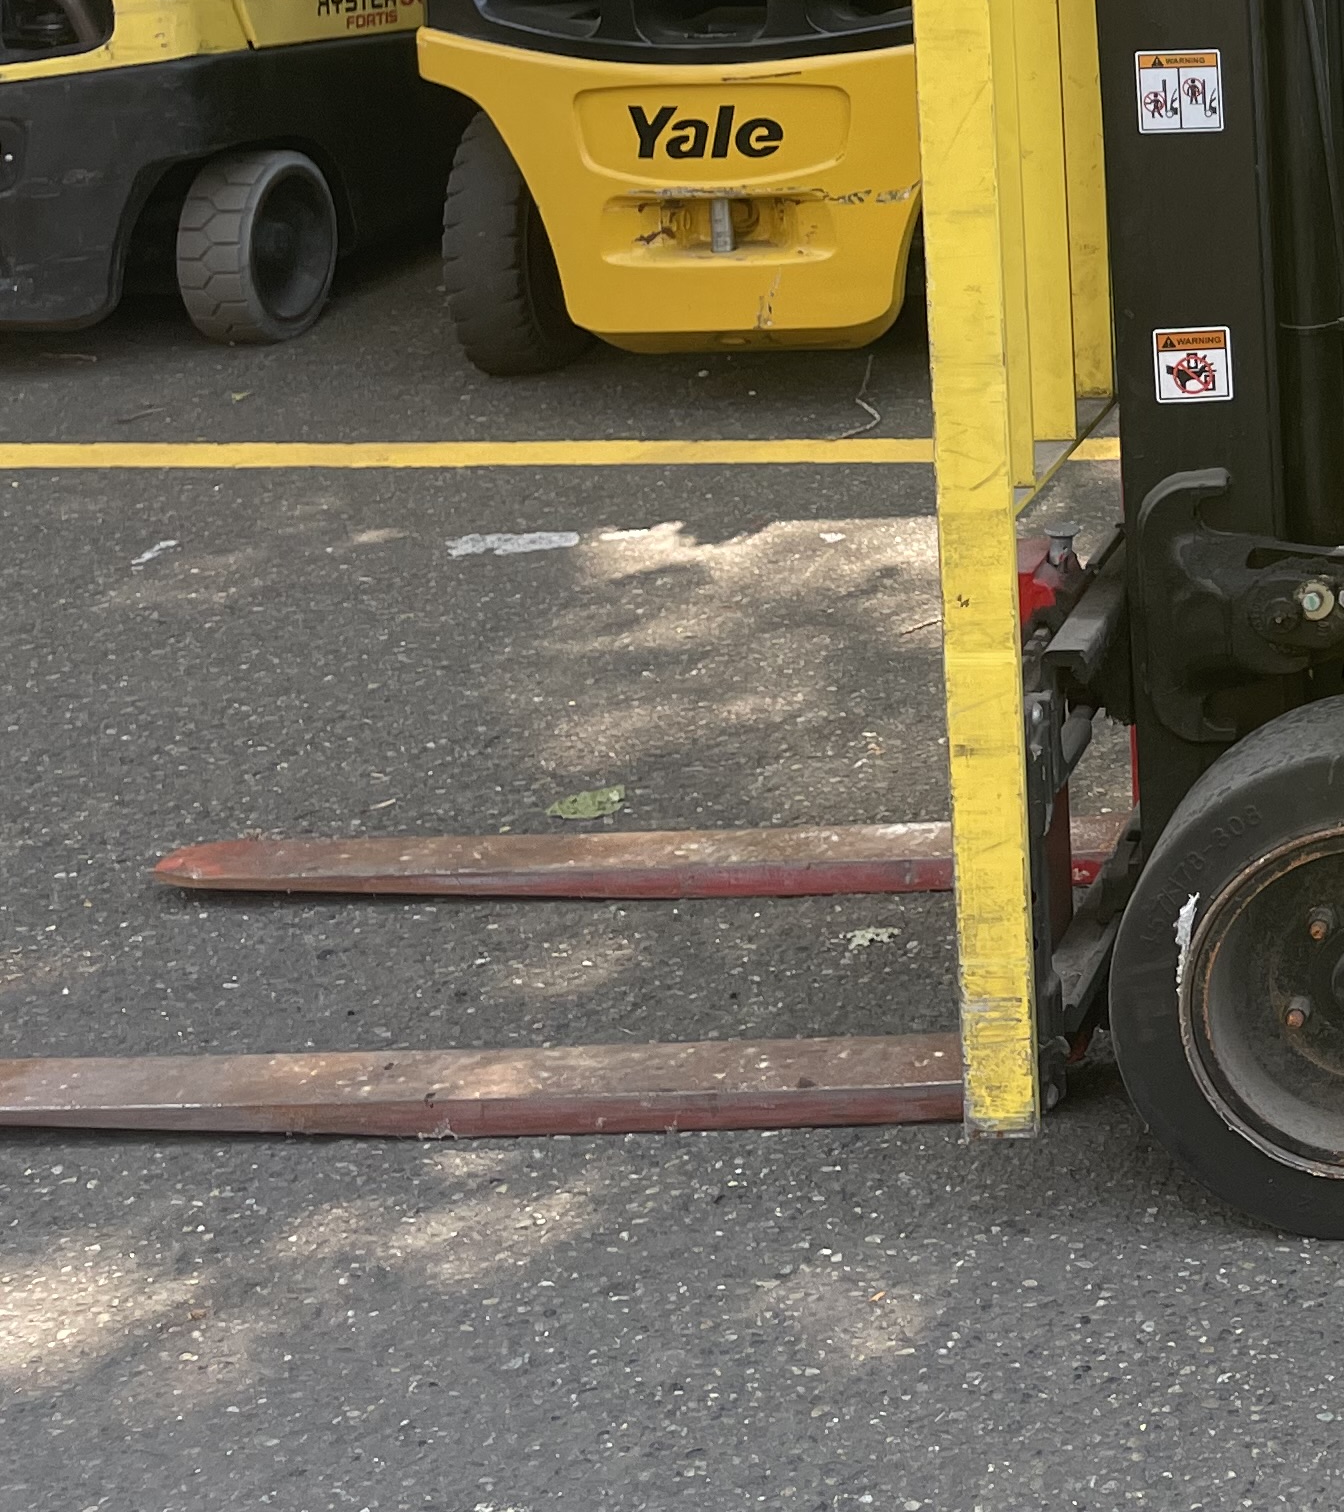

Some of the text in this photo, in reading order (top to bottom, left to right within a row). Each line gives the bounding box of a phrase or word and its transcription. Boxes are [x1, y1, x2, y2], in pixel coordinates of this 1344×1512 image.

[346, 9, 398, 29] FORTIS
[1165, 57, 1205, 65] WARNING
[628, 105, 784, 159] Yale
[1176, 336, 1222, 346] WARNING
